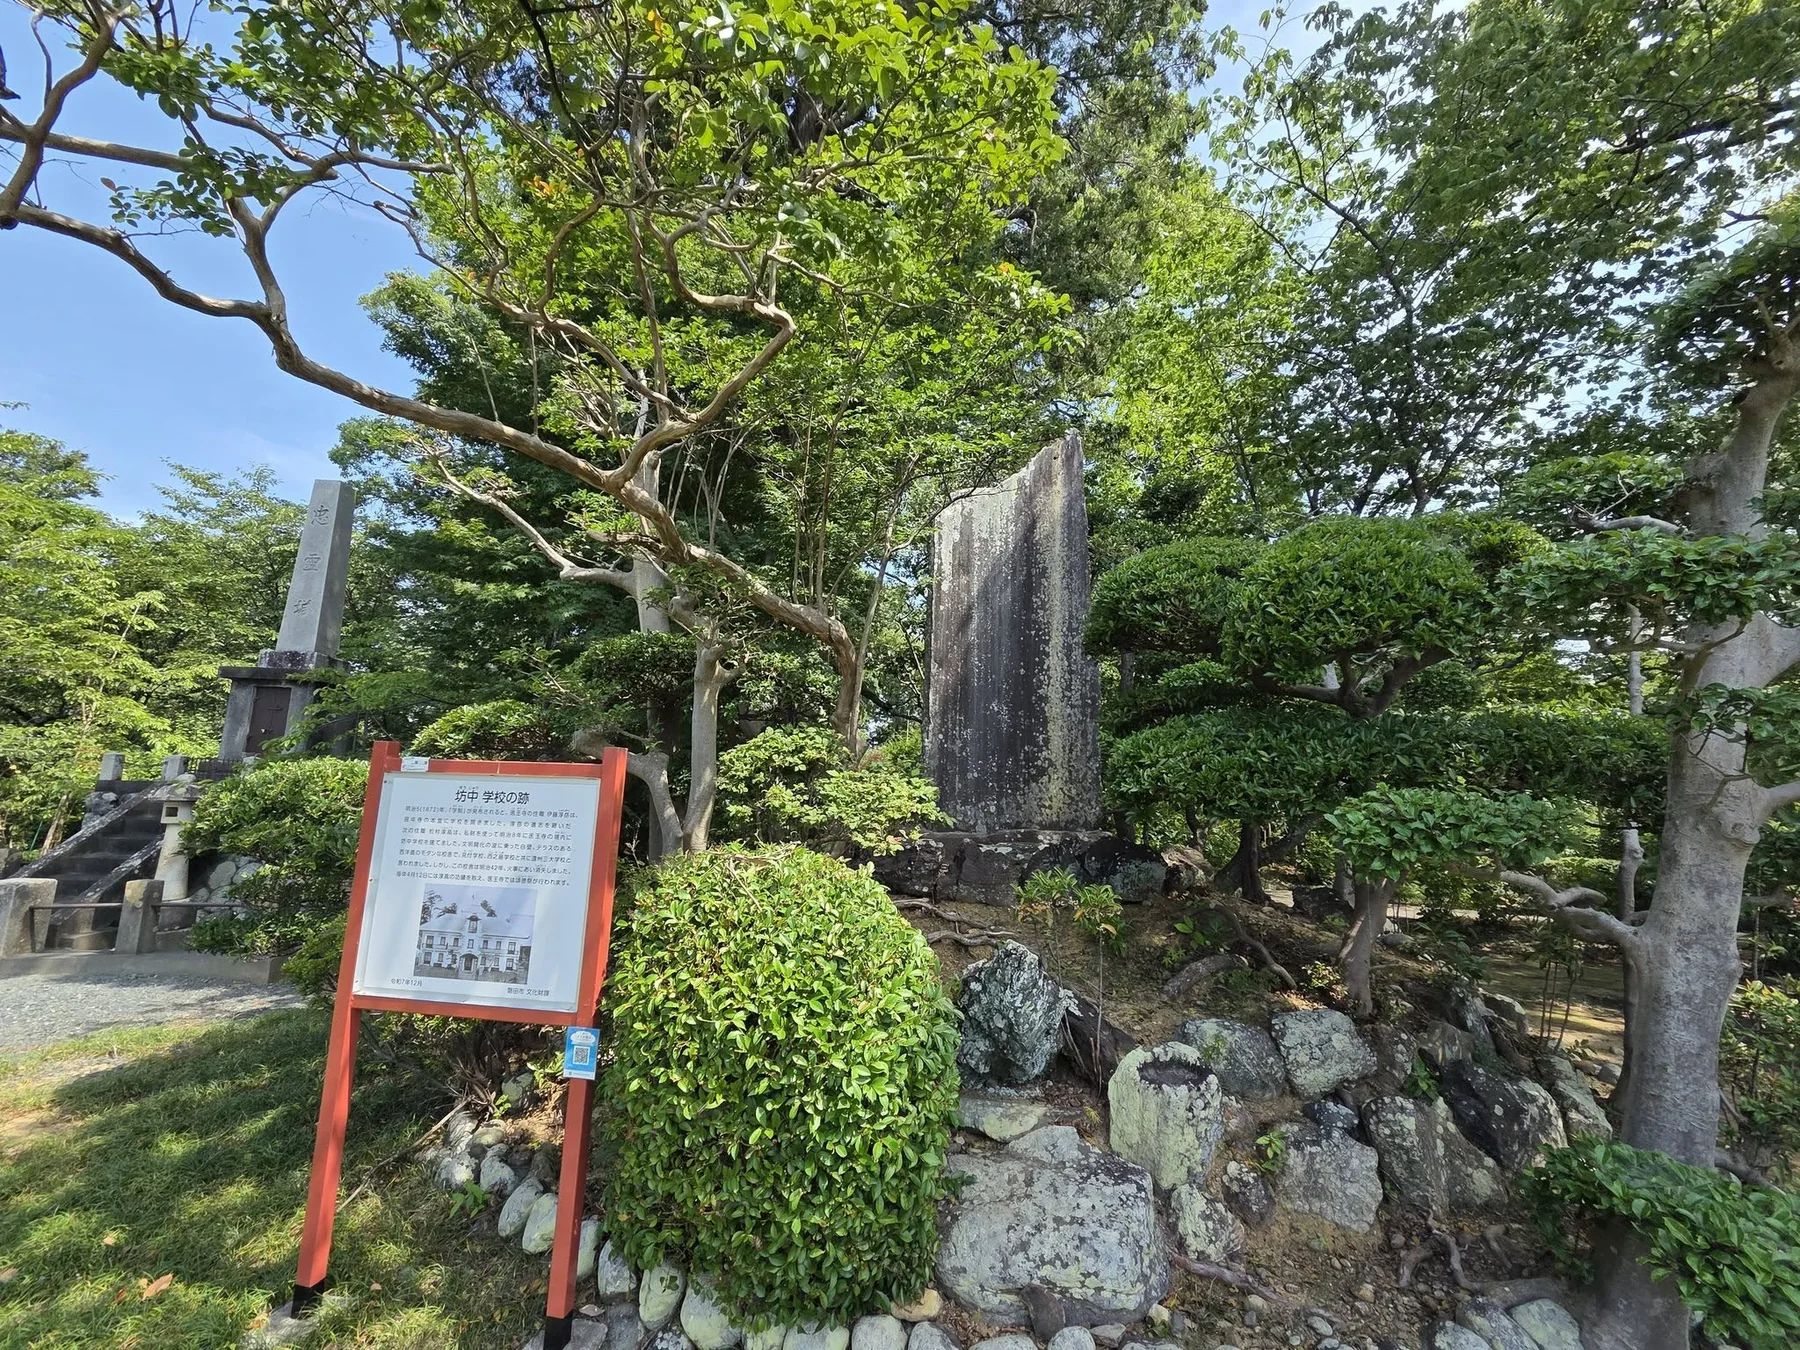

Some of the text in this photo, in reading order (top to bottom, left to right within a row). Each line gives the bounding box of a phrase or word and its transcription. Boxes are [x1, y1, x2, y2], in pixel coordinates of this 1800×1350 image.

[454, 789, 530, 805] 坊中 学校の跡
